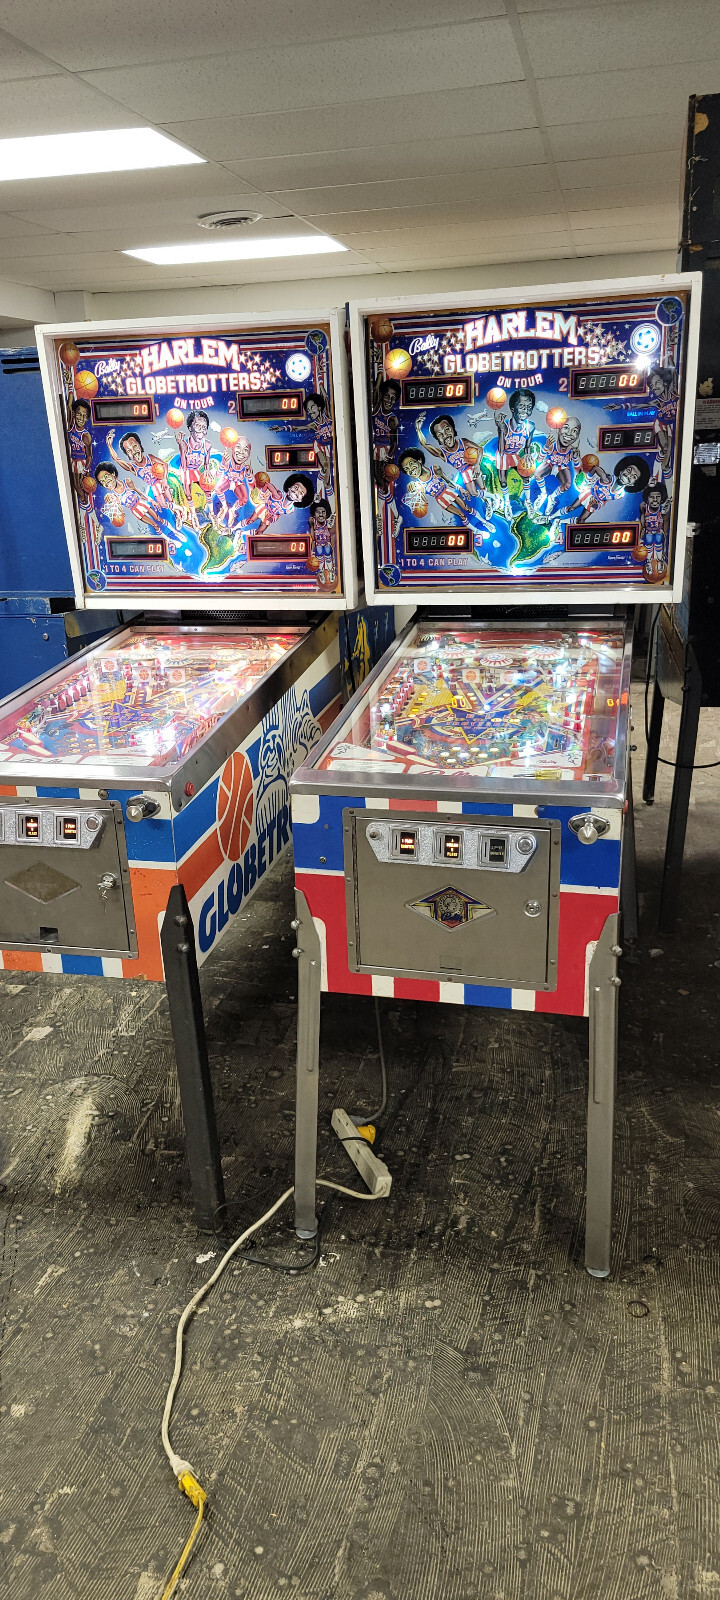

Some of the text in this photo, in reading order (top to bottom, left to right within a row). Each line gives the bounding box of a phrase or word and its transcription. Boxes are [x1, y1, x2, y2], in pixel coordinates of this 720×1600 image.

[463, 310, 579, 352] HARLEM
[408, 335, 439, 356] Bally
[140, 338, 241, 377] HARLEM
[443, 346, 603, 373] GLOBETROTTERS
[94, 357, 121, 378] Bally
[125, 372, 262, 396] GLOBETROTTERS
[496, 373, 543, 388] ON TOUR
[558, 378, 568, 392] 2
[173, 396, 215, 410] ON TOUR
[227, 400, 236, 414] 2
[474, 533, 484, 547] 3
[555, 532, 564, 545] 4
[168, 542, 177, 555] 3
[110, 565, 120, 573] TO
[129, 565, 145, 573] CAN
[406, 558, 417, 567] TO
[420, 558, 425, 567] 4
[428, 558, 445, 567] CAN
[447, 558, 468, 566] PLAY
[198, 804, 293, 953] GLOBETR
